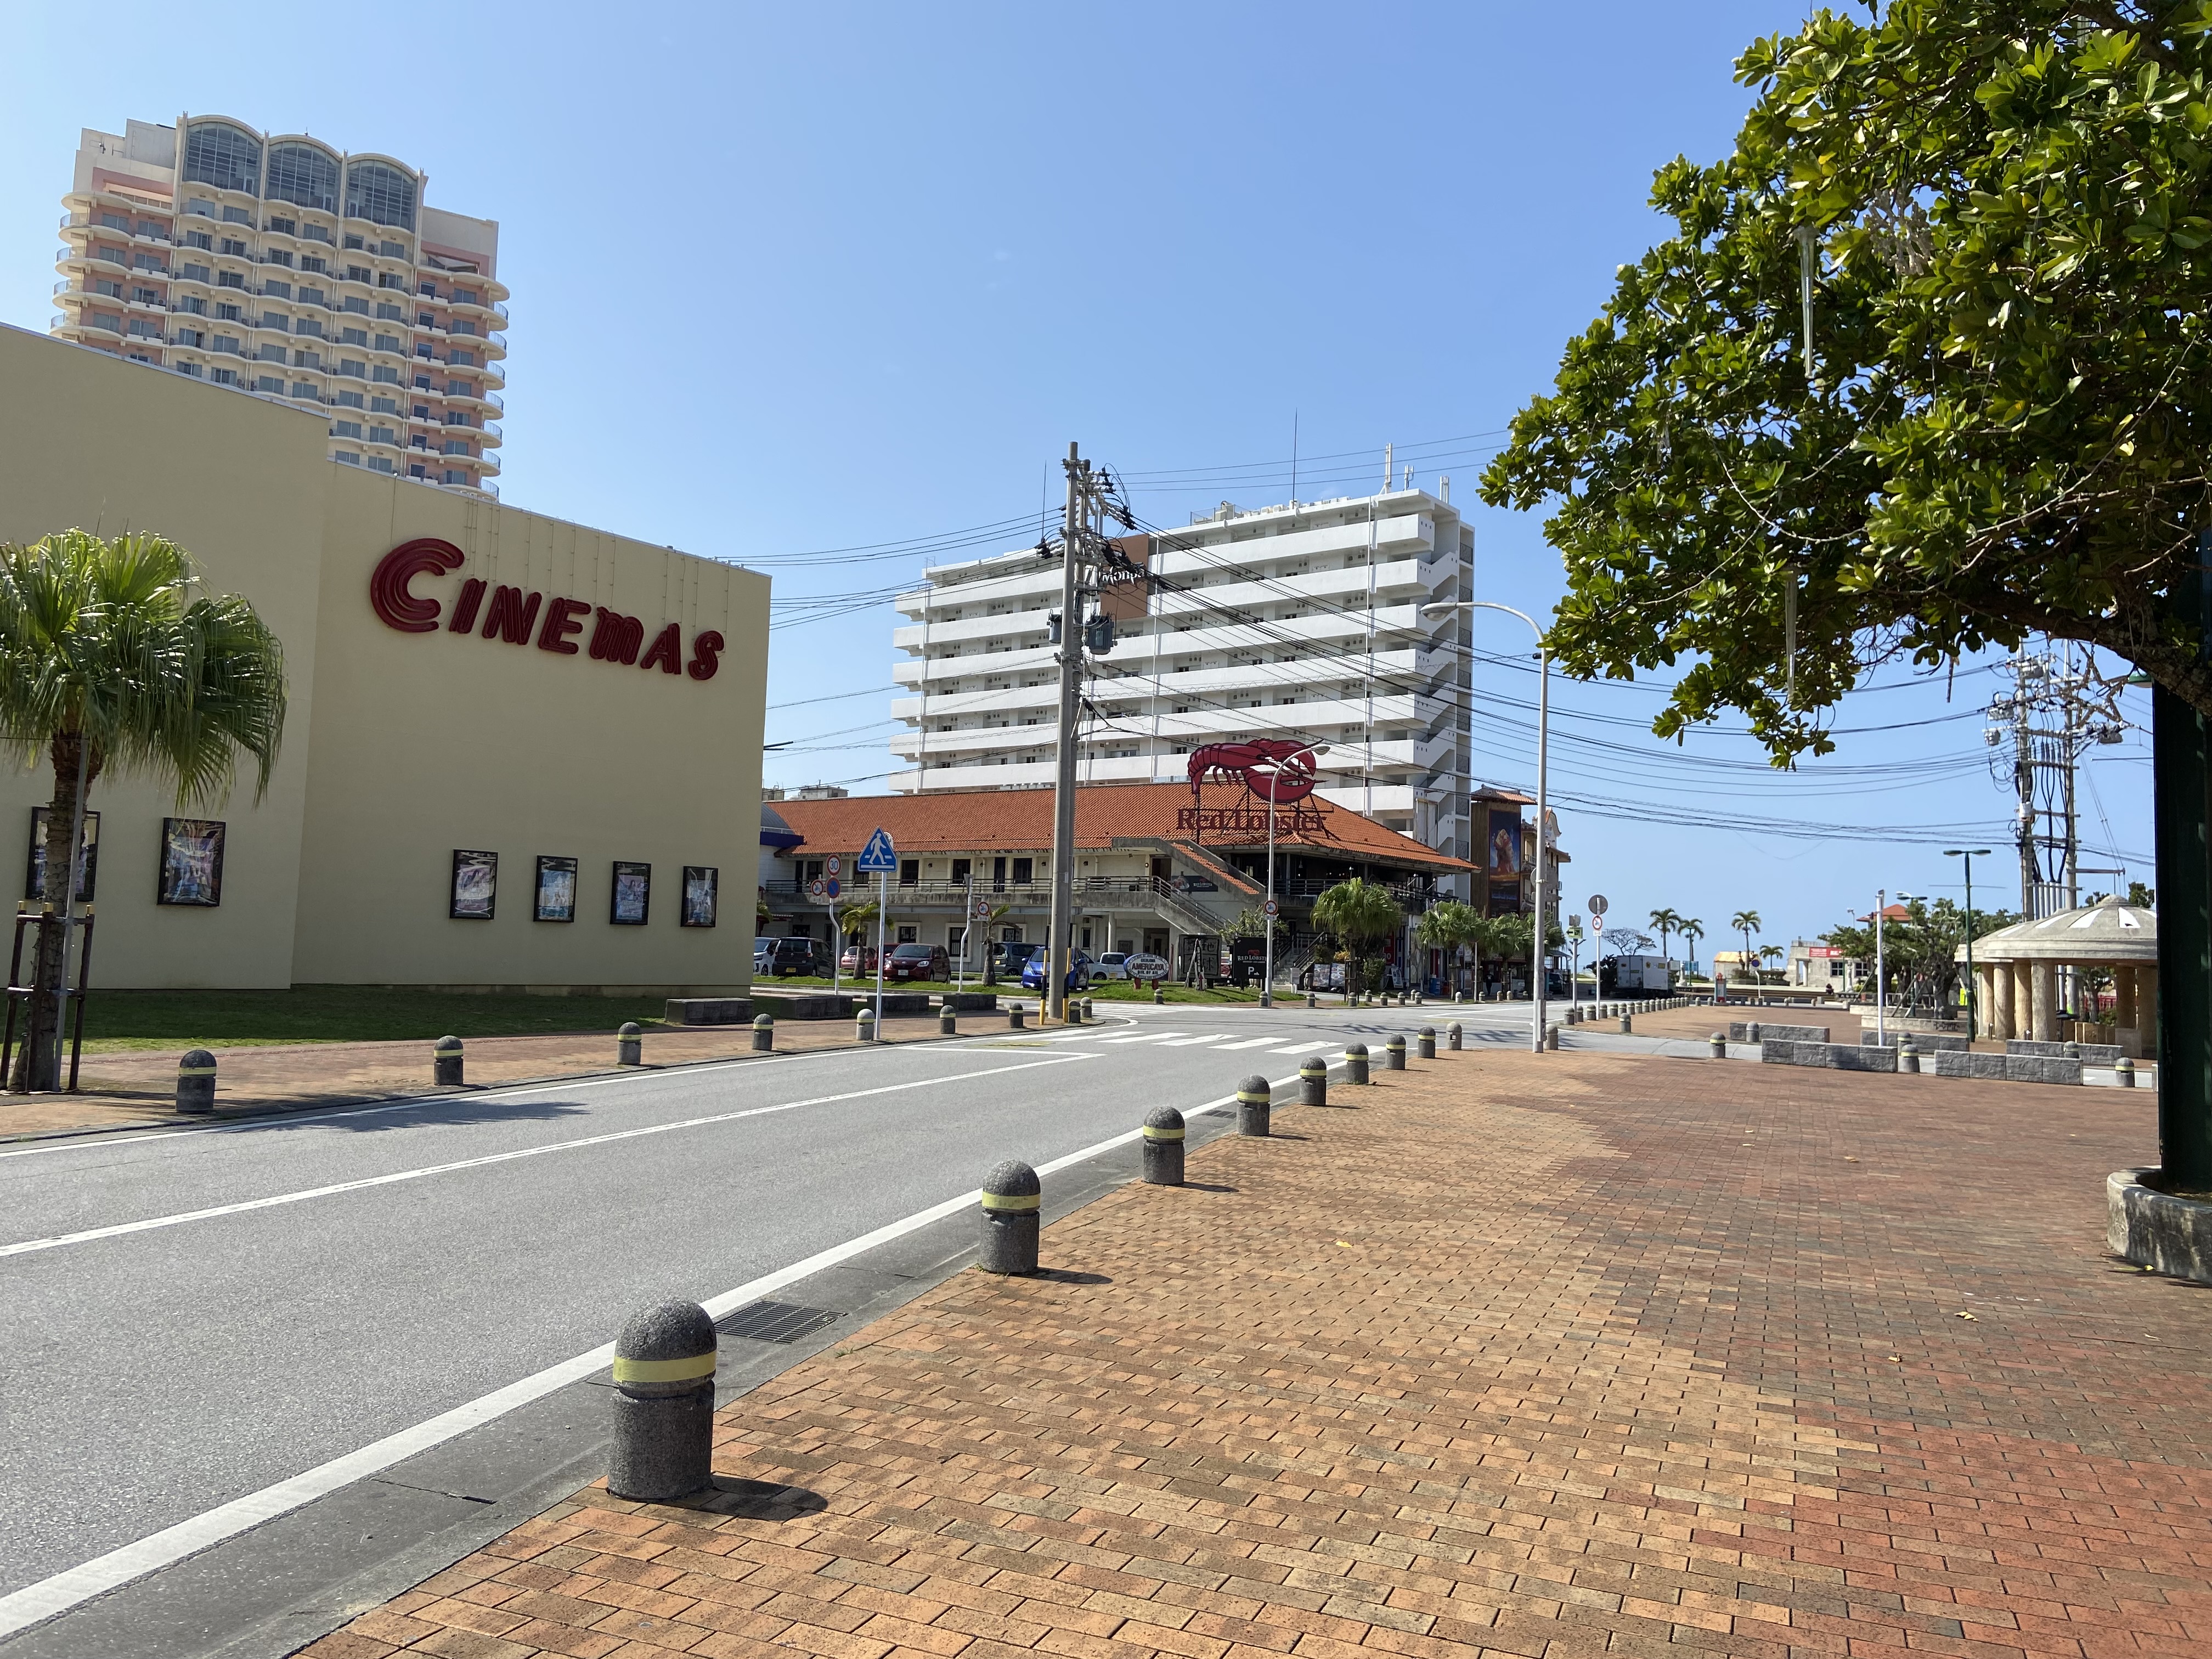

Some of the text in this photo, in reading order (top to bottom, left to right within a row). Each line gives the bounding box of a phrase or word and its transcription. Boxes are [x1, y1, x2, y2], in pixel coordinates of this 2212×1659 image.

[1176, 809, 1327, 832] Red Lobster
[830, 860, 838, 870] 30
[1248, 966, 1255, 975] P
